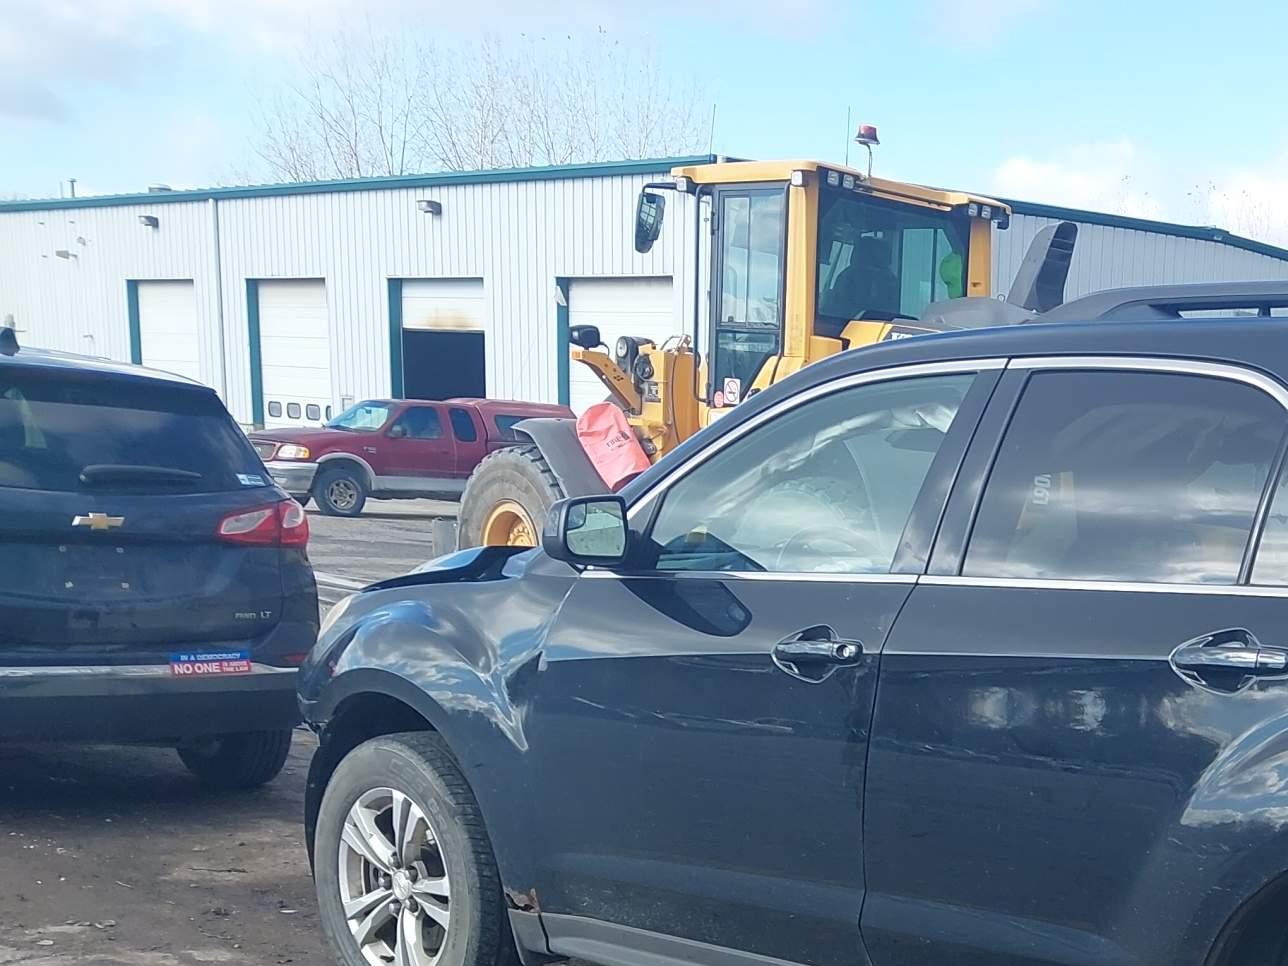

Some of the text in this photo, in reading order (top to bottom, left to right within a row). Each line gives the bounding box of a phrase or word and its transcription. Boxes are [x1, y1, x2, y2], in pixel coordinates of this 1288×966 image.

[260, 610, 272, 619] LT
[174, 662, 221, 675] NO ONE
